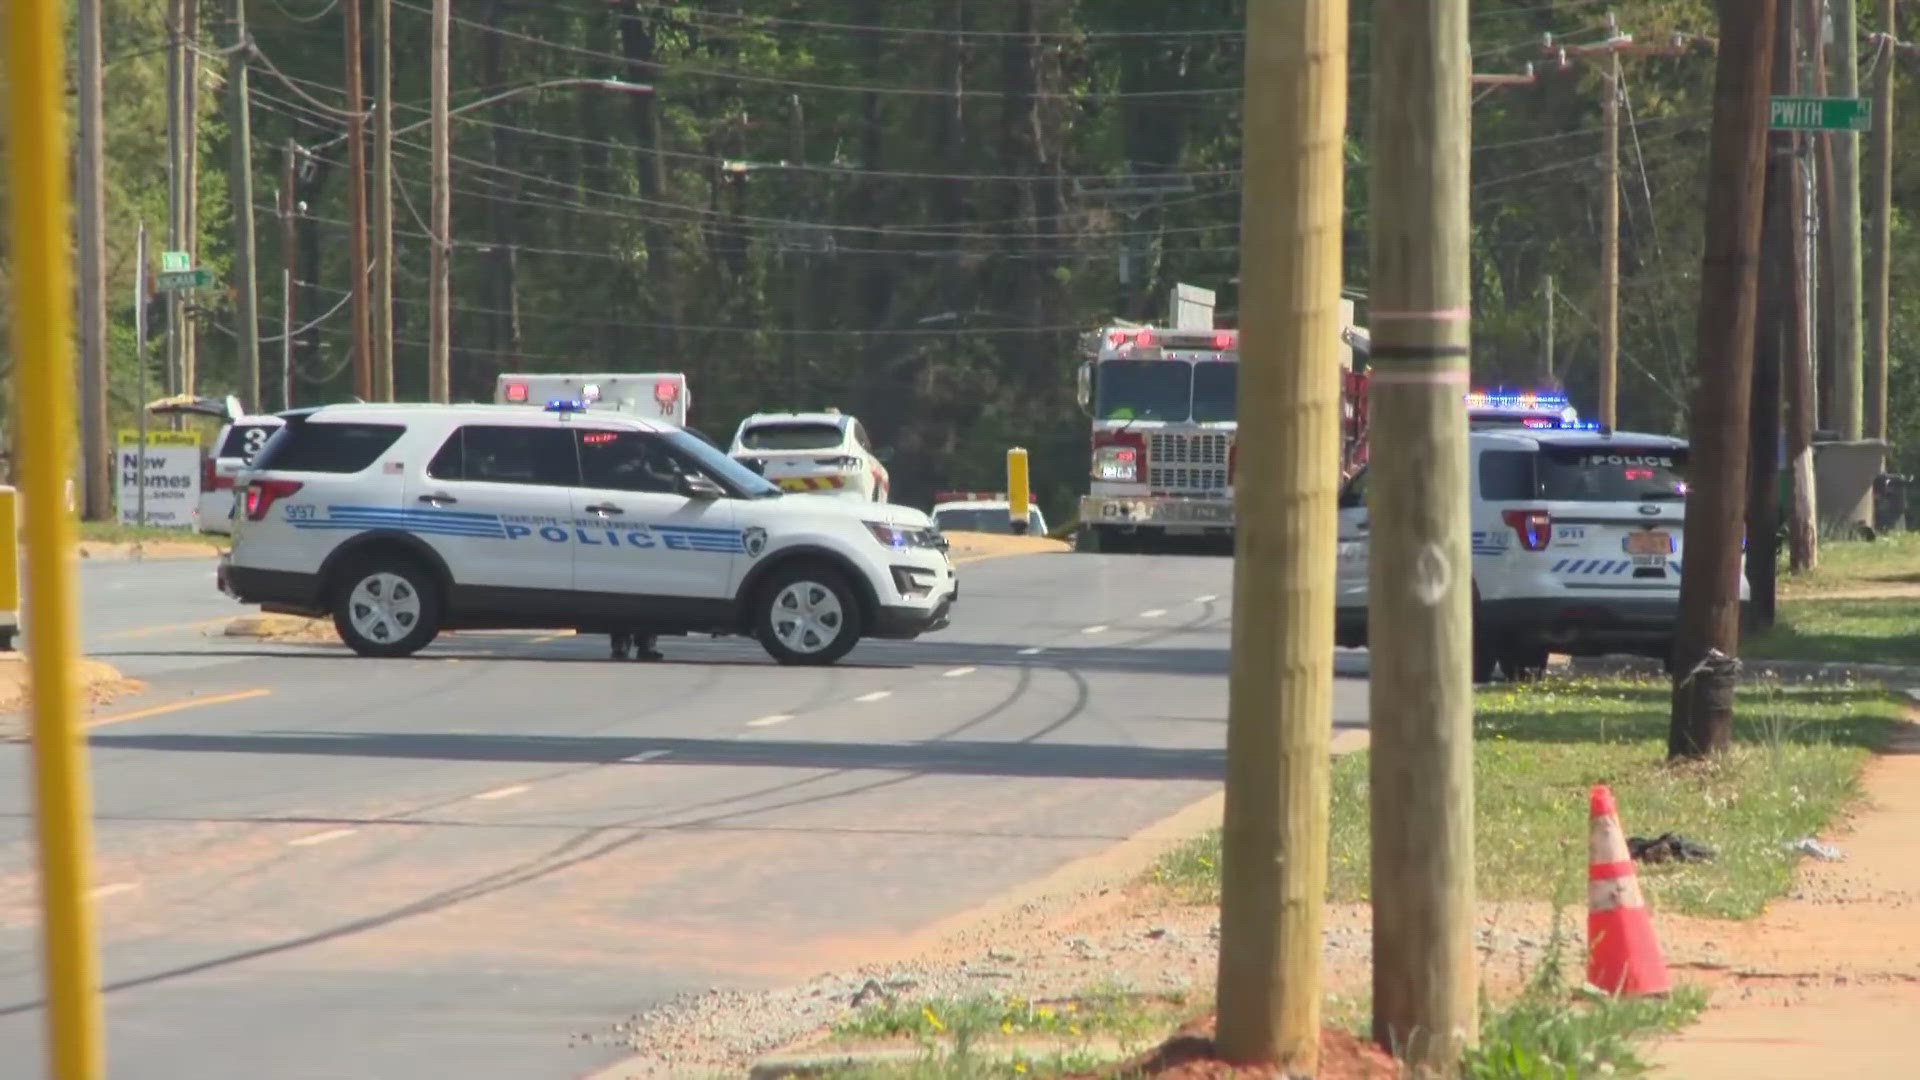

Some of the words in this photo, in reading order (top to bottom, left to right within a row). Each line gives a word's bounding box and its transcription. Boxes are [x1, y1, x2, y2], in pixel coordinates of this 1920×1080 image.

[1770, 101, 1823, 126] PWITH
[1592, 454, 1674, 467] POLICE
[285, 504, 316, 519] 997
[503, 524, 688, 551] POLICE
